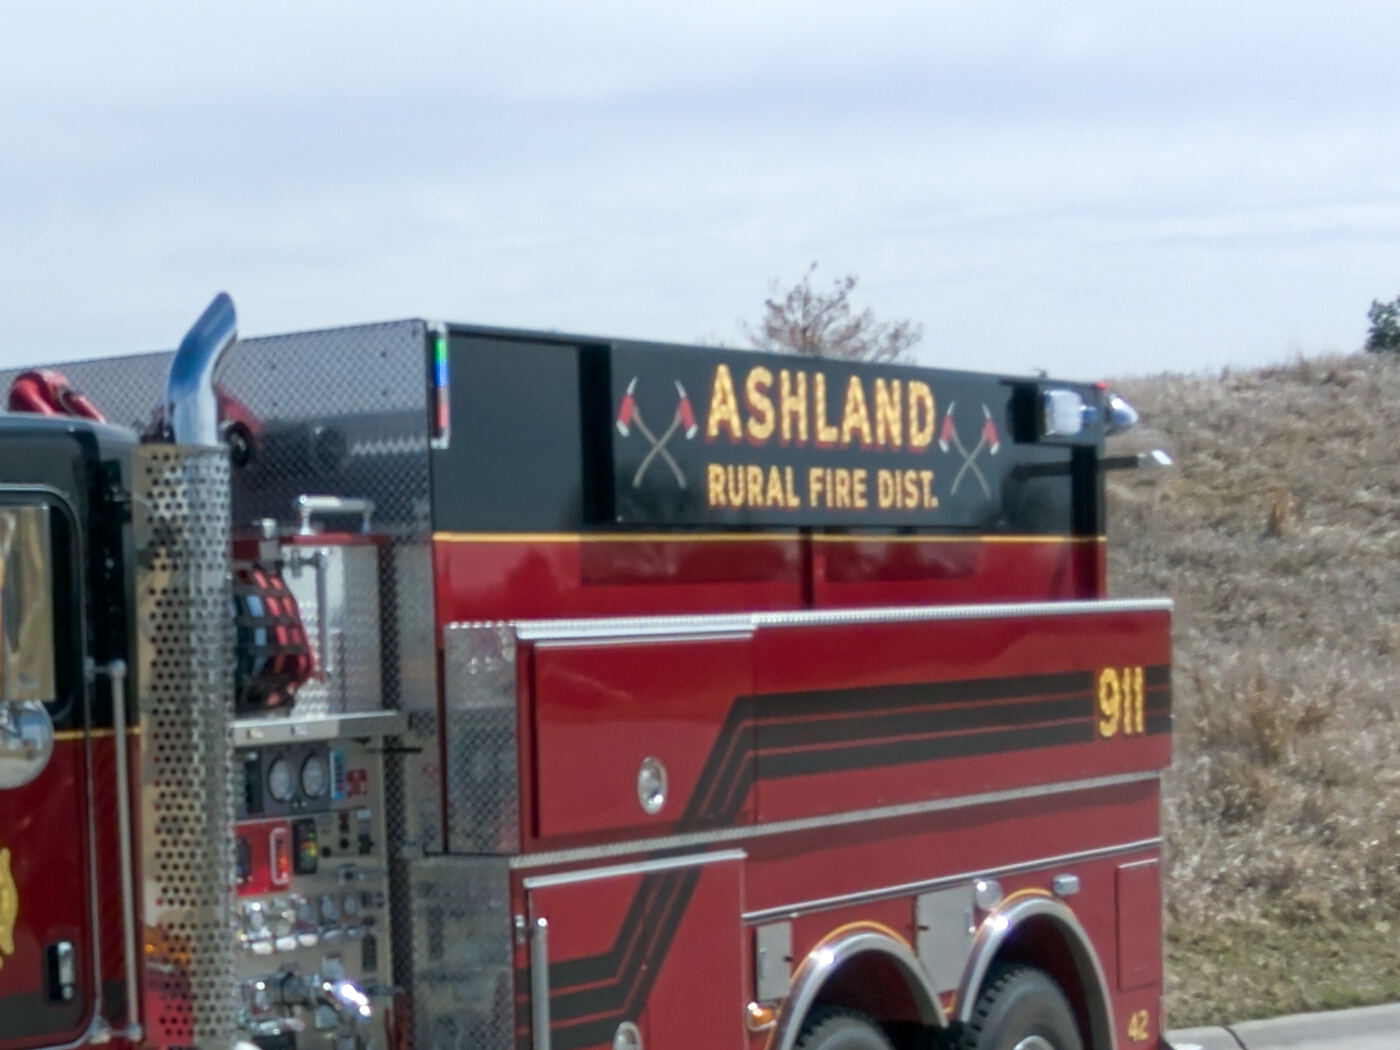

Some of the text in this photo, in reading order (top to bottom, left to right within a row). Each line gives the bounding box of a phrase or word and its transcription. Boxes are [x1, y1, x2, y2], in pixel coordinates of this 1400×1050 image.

[706, 363, 936, 448] ASHLAND
[707, 463, 939, 509] RURAL FIRE DIST.
[1099, 667, 1144, 737] 911
[1128, 1009, 1150, 1042] 42
